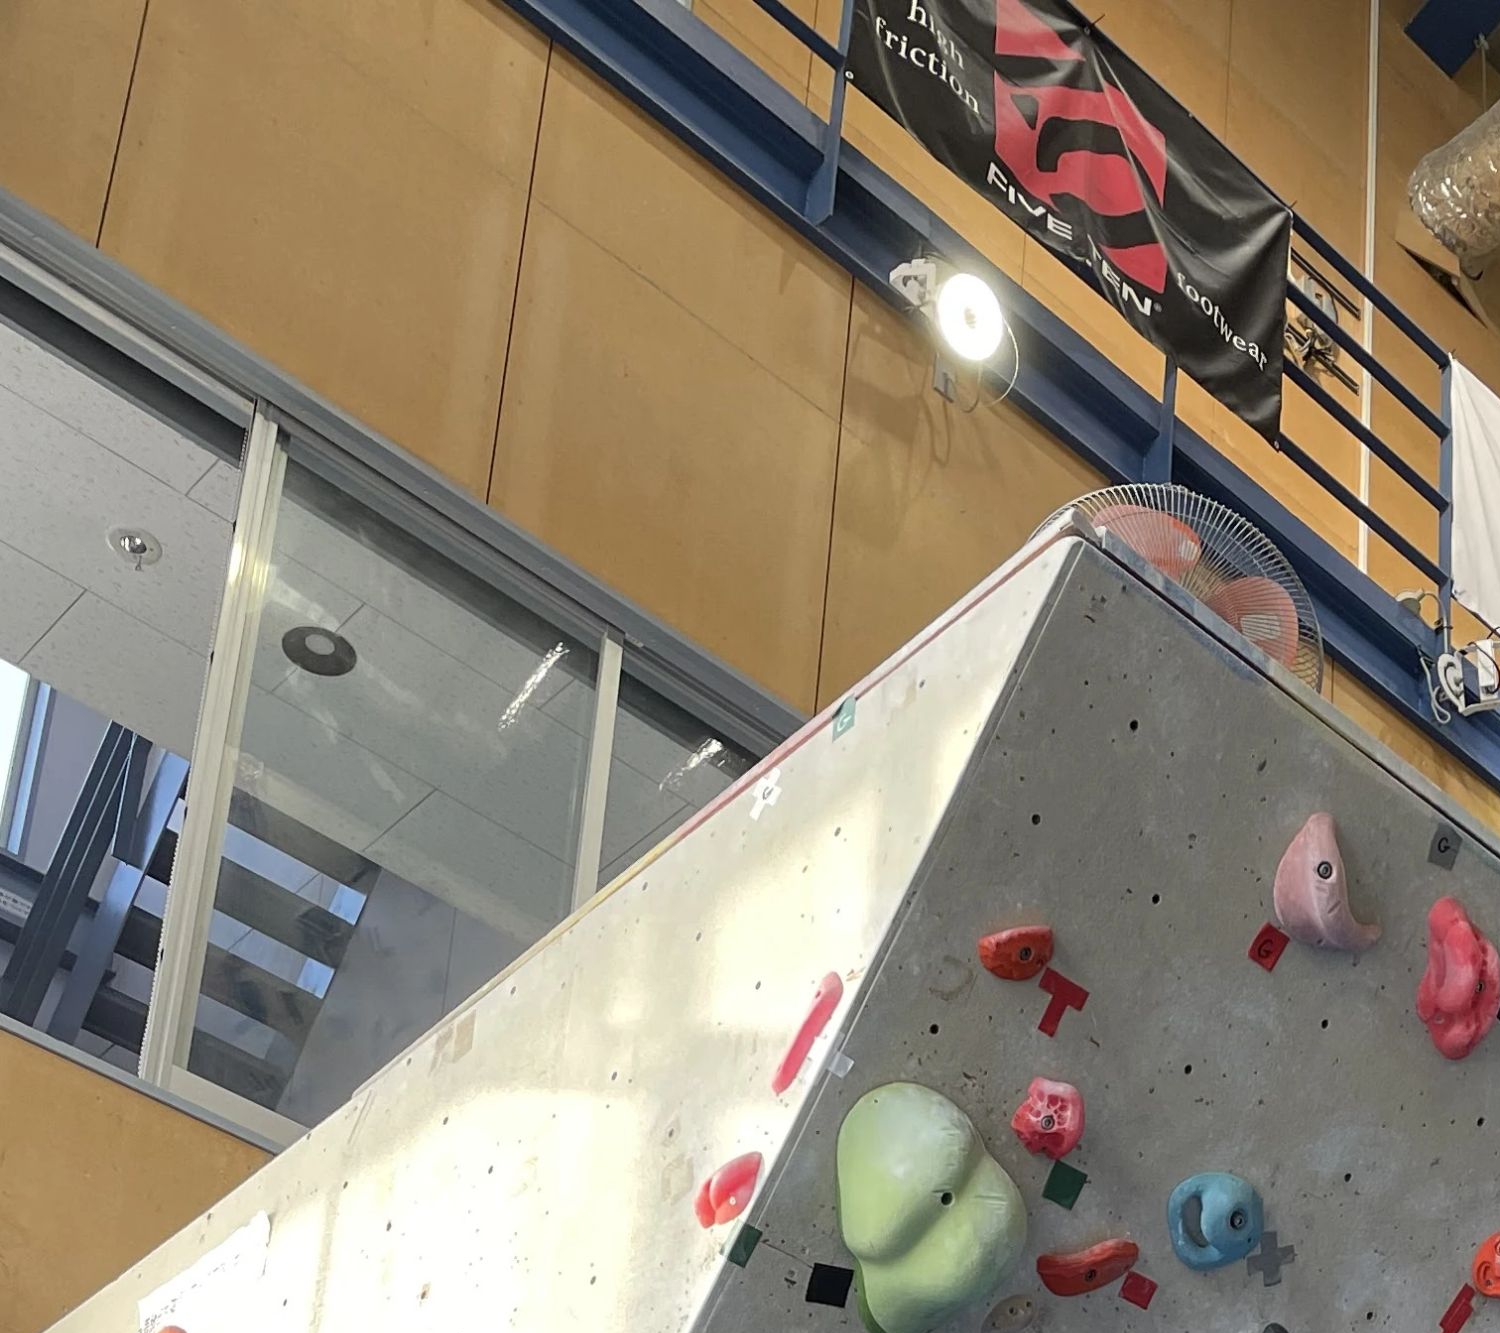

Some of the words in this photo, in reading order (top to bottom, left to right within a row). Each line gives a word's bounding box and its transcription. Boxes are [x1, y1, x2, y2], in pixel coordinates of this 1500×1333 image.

[875, 16, 980, 115] friction
[986, 161, 1073, 241] FIVE
[1177, 272, 1269, 372] footwear
[1438, 837, 1450, 853] G
[1257, 938, 1274, 960] G
